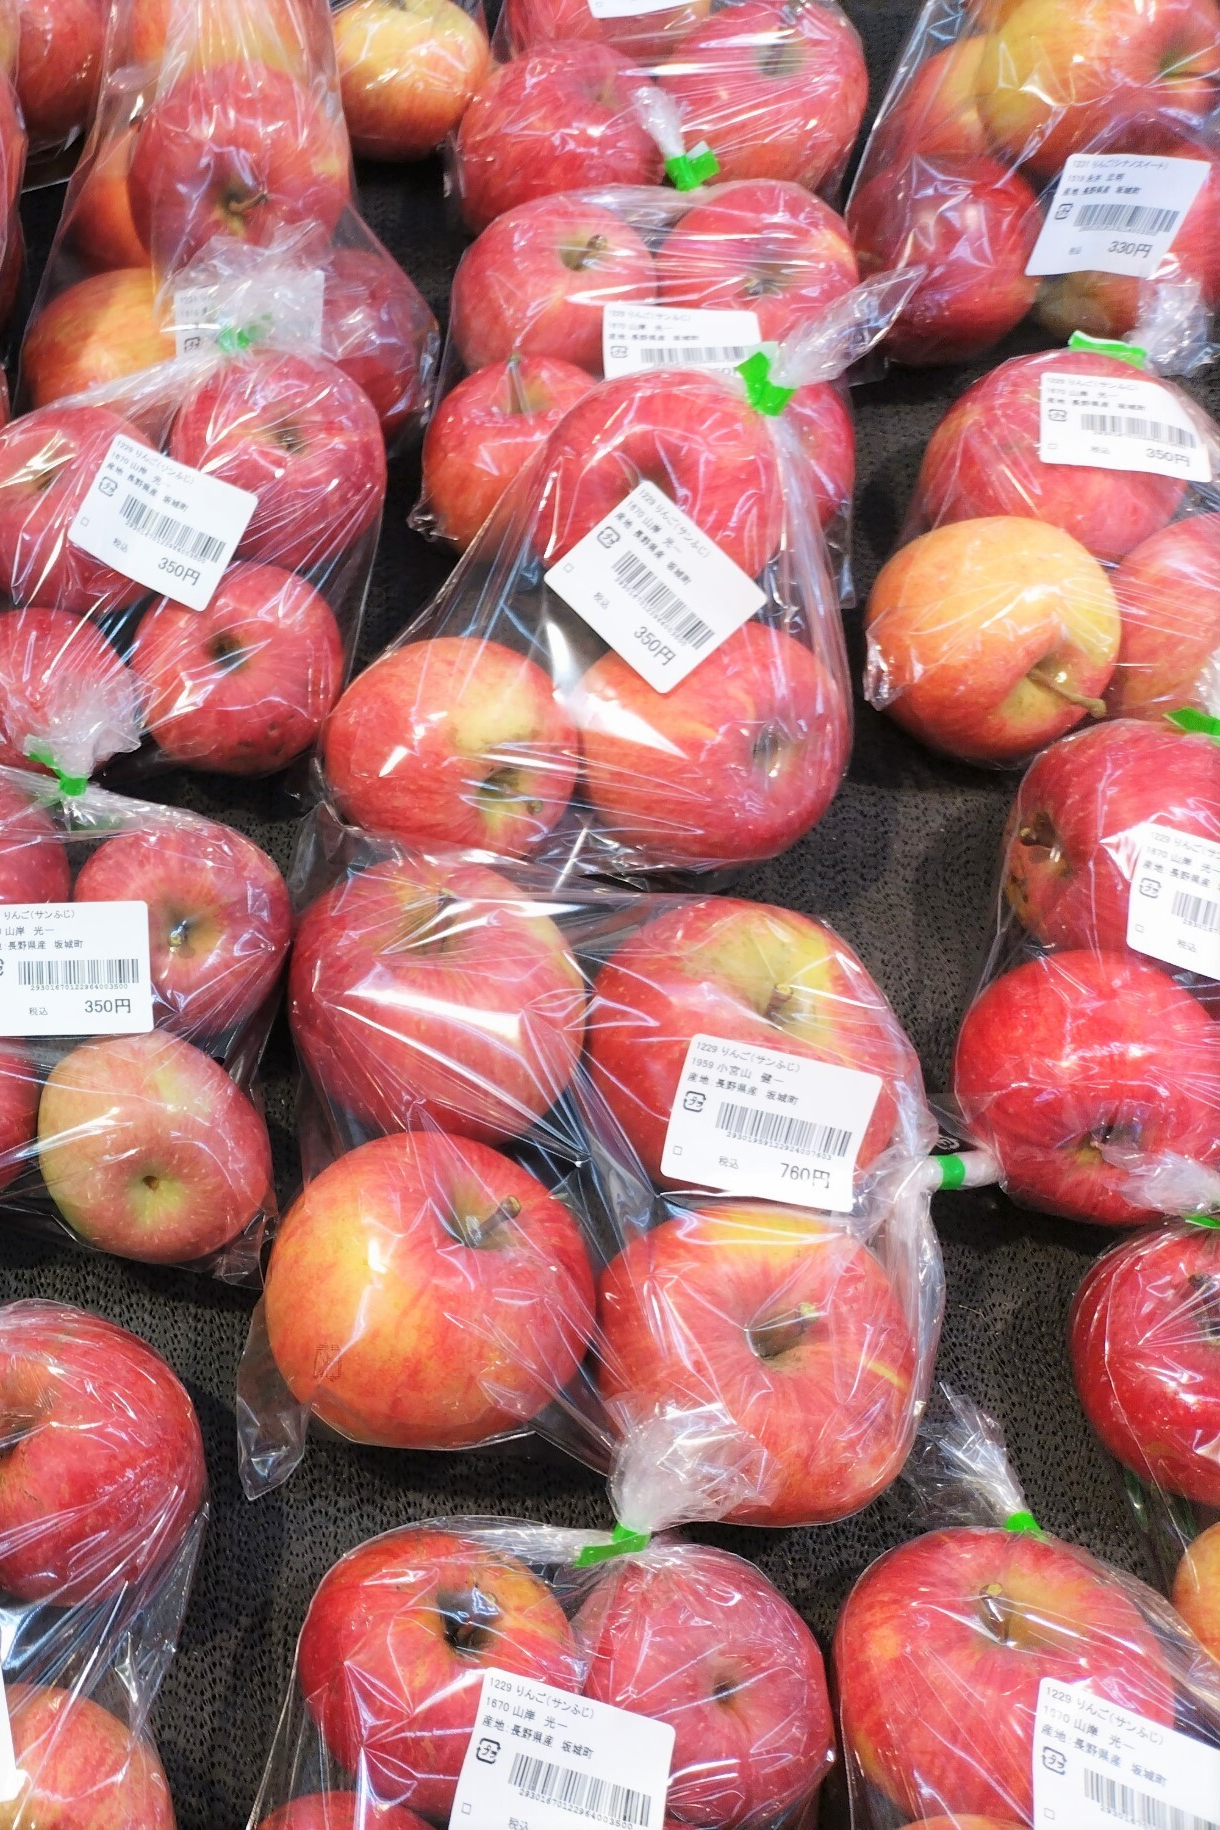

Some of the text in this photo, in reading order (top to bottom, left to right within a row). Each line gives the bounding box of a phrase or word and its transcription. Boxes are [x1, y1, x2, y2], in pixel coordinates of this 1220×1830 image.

[1107, 240, 1154, 258] 330円
[1146, 448, 1190, 467] 350円
[157, 557, 201, 586] 350円
[633, 625, 677, 666] 350円
[3, 910, 76, 920] りんご(サンふじ)
[5, 926, 25, 937] 山岸
[33, 926, 55, 936] 光一
[28, 998, 131, 1016] 税込 350円
[691, 1057, 714, 1069] 1959
[716, 1063, 752, 1080] 小宮山
[696, 1041, 801, 1073] 1229 りんご(サンふじ)
[718, 1156, 831, 1189] 税込 760円
[486, 1696, 569, 1730] 1670 山岸 光一
[489, 1676, 595, 1720] 1229 りんご(サンふじ)
[1045, 1686, 1164, 1746] 1229 りんご(サンふじ)
[1073, 1717, 1100, 1737] 山岸
[1108, 1734, 1136, 1751] 光一
